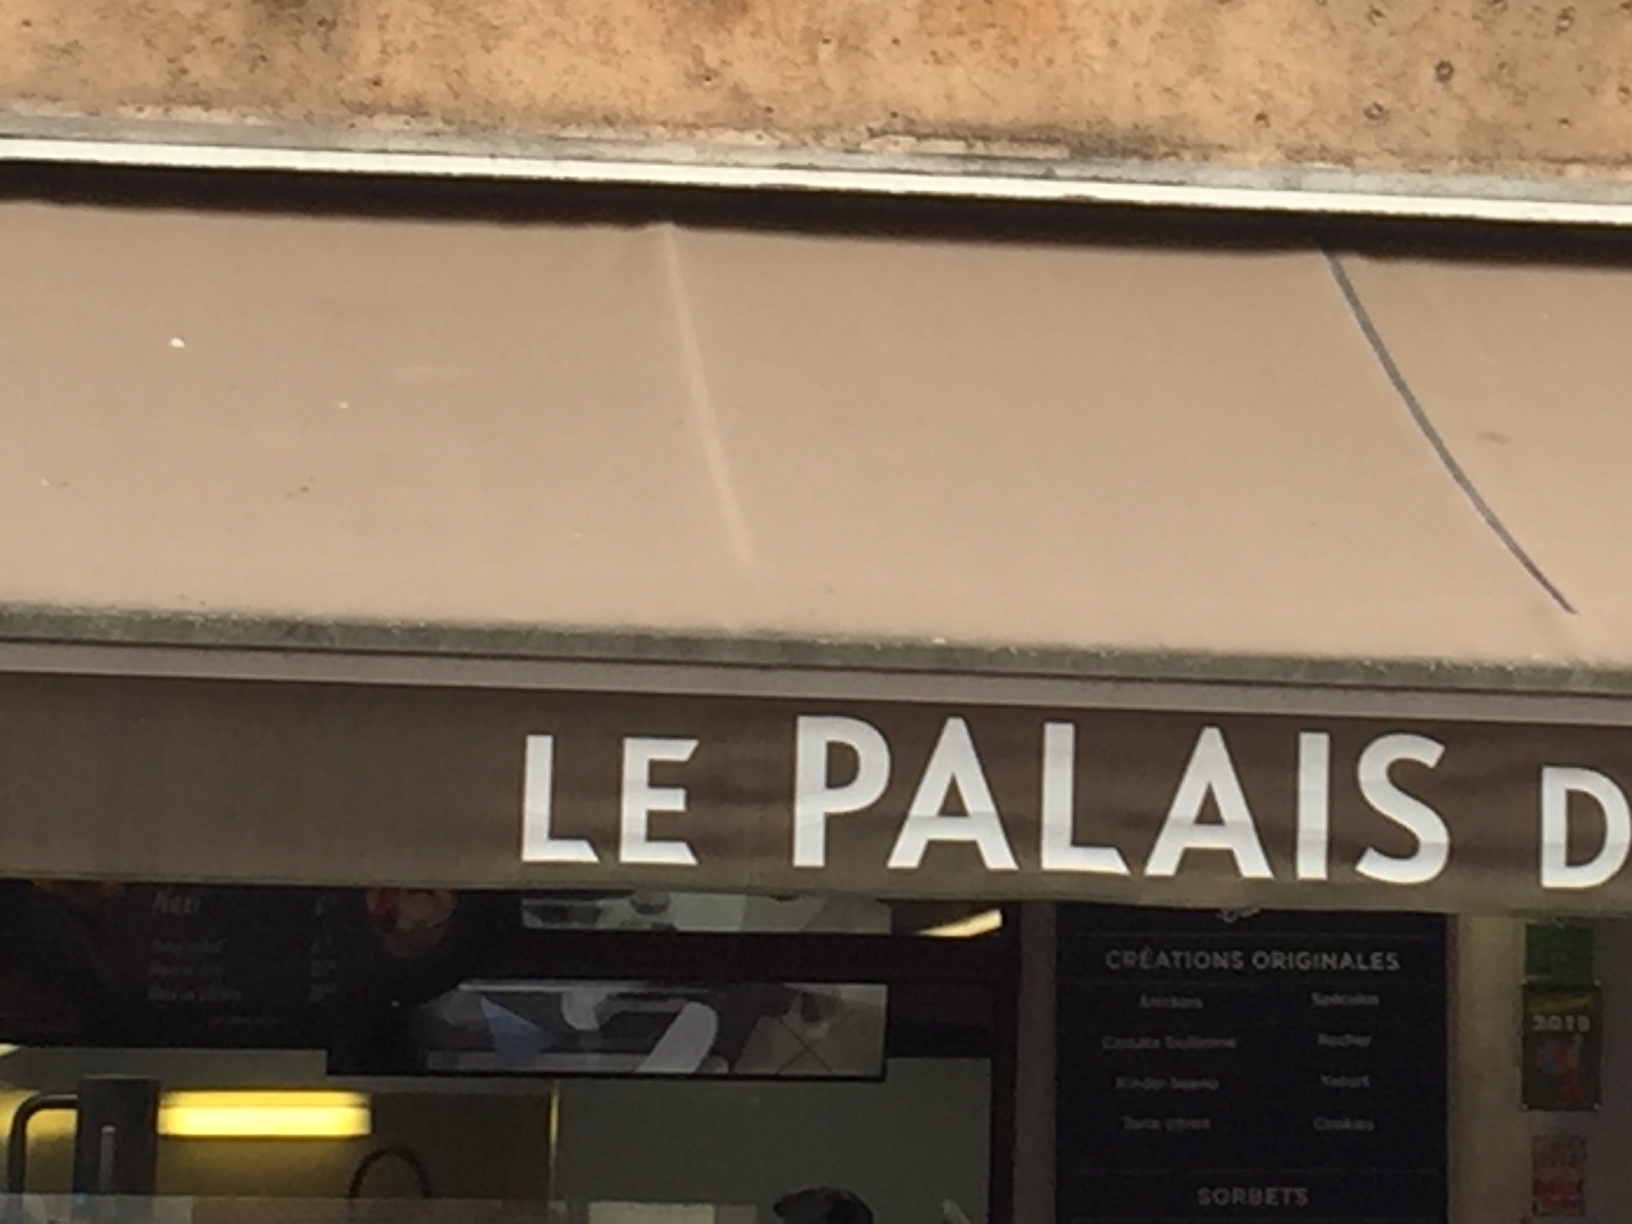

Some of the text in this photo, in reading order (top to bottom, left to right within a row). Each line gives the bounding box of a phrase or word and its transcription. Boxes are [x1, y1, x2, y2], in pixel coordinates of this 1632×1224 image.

[521, 734, 699, 866] LE
[793, 715, 1450, 885] PALAIS
[1251, 950, 1401, 971] ORIGINALES
[1197, 1186, 1309, 1207] SORBETS
